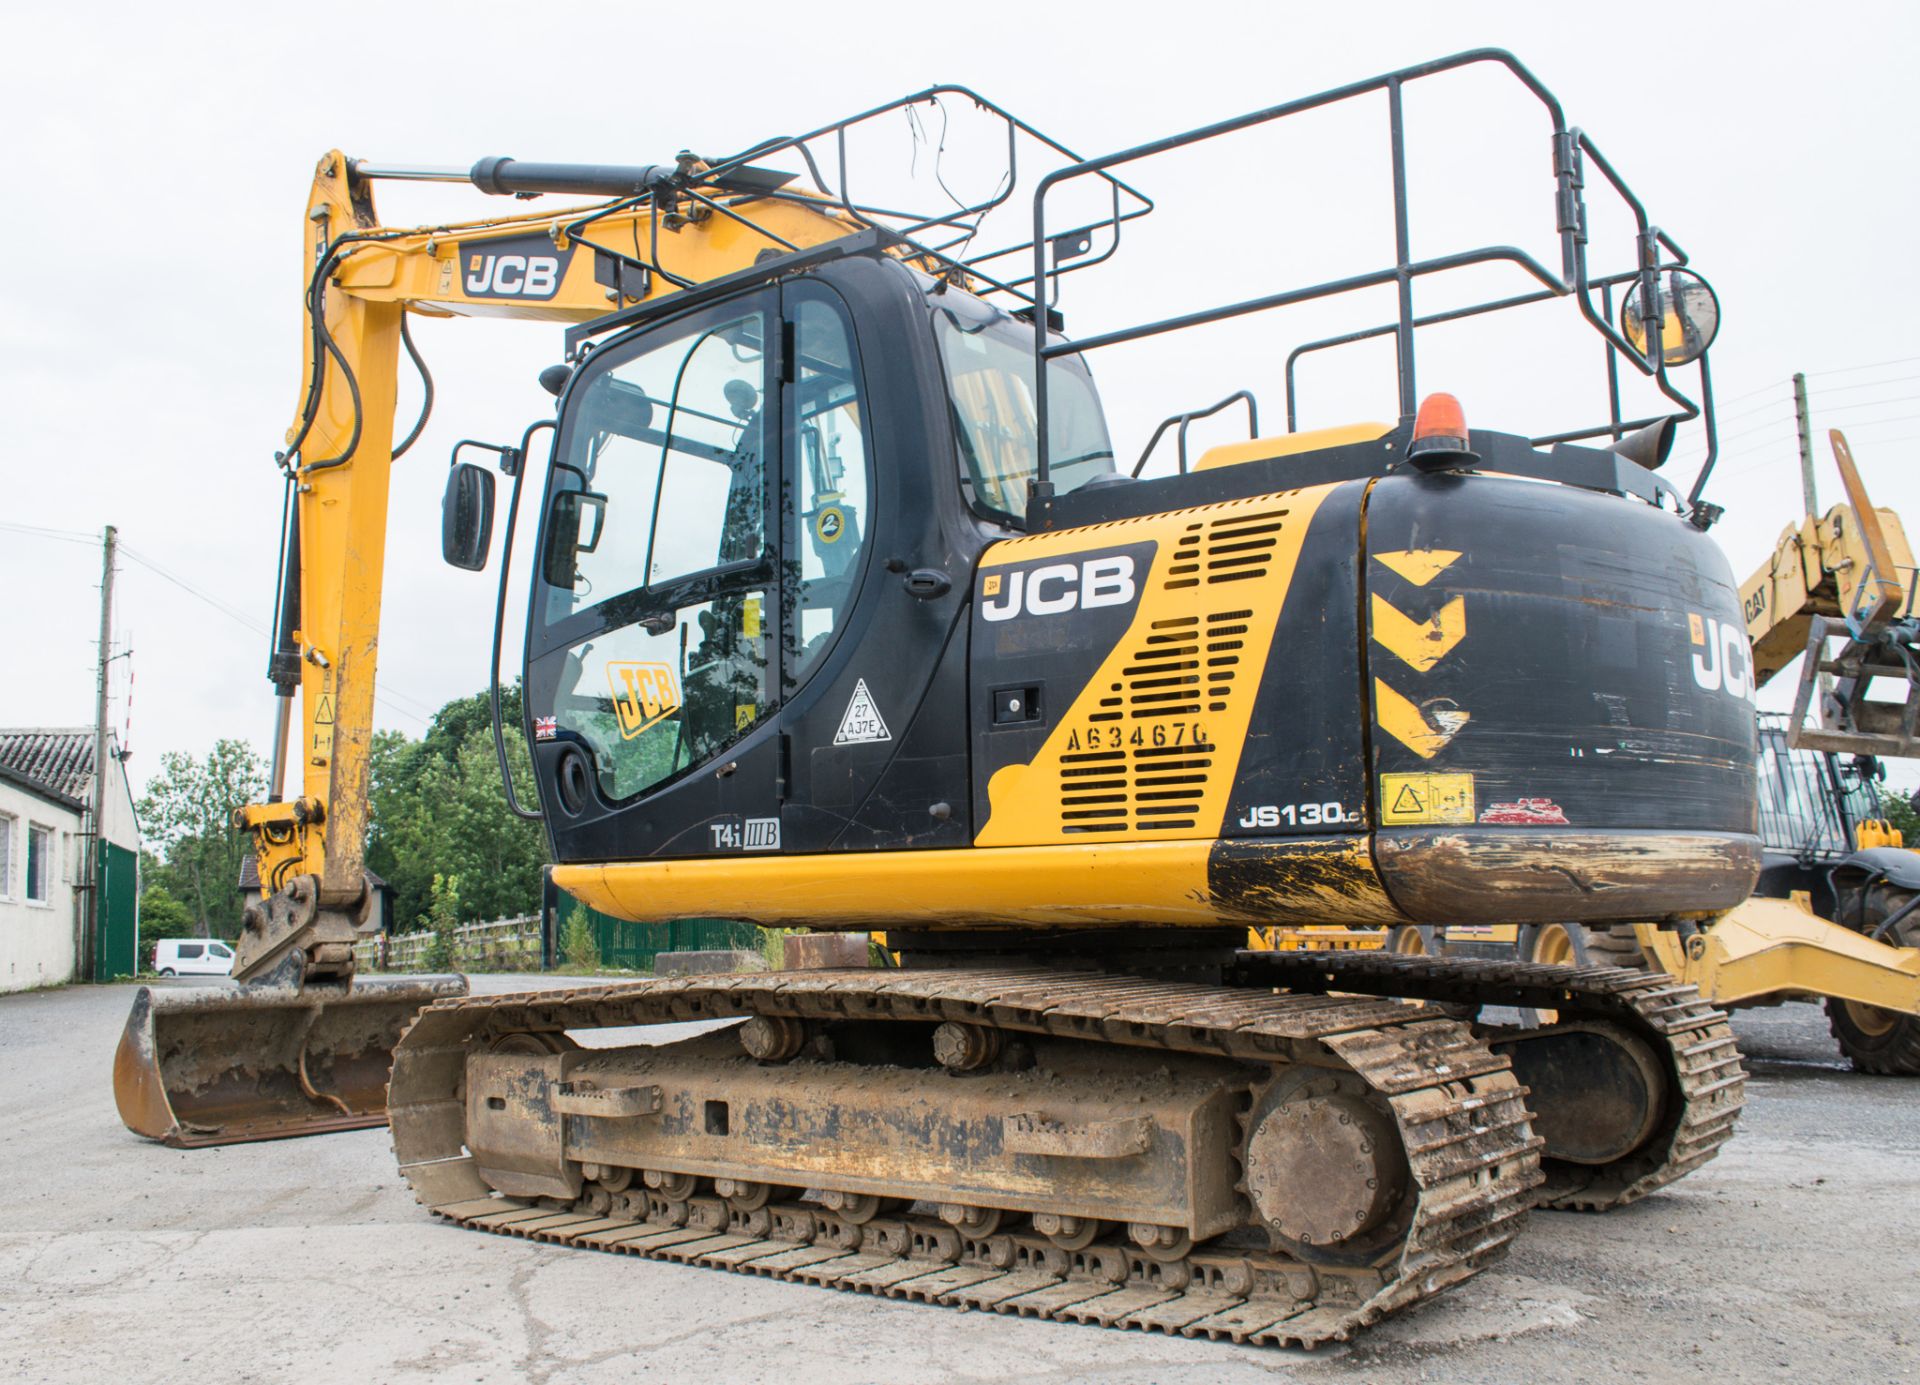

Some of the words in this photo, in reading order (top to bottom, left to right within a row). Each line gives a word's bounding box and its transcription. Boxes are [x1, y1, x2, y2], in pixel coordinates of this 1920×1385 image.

[467, 255, 559, 295] JCB
[982, 555, 1136, 622] JCB
[1745, 584, 1766, 624] CAT
[619, 668, 674, 730] JCB
[855, 703, 868, 718] 27
[710, 823, 742, 848] T4i
